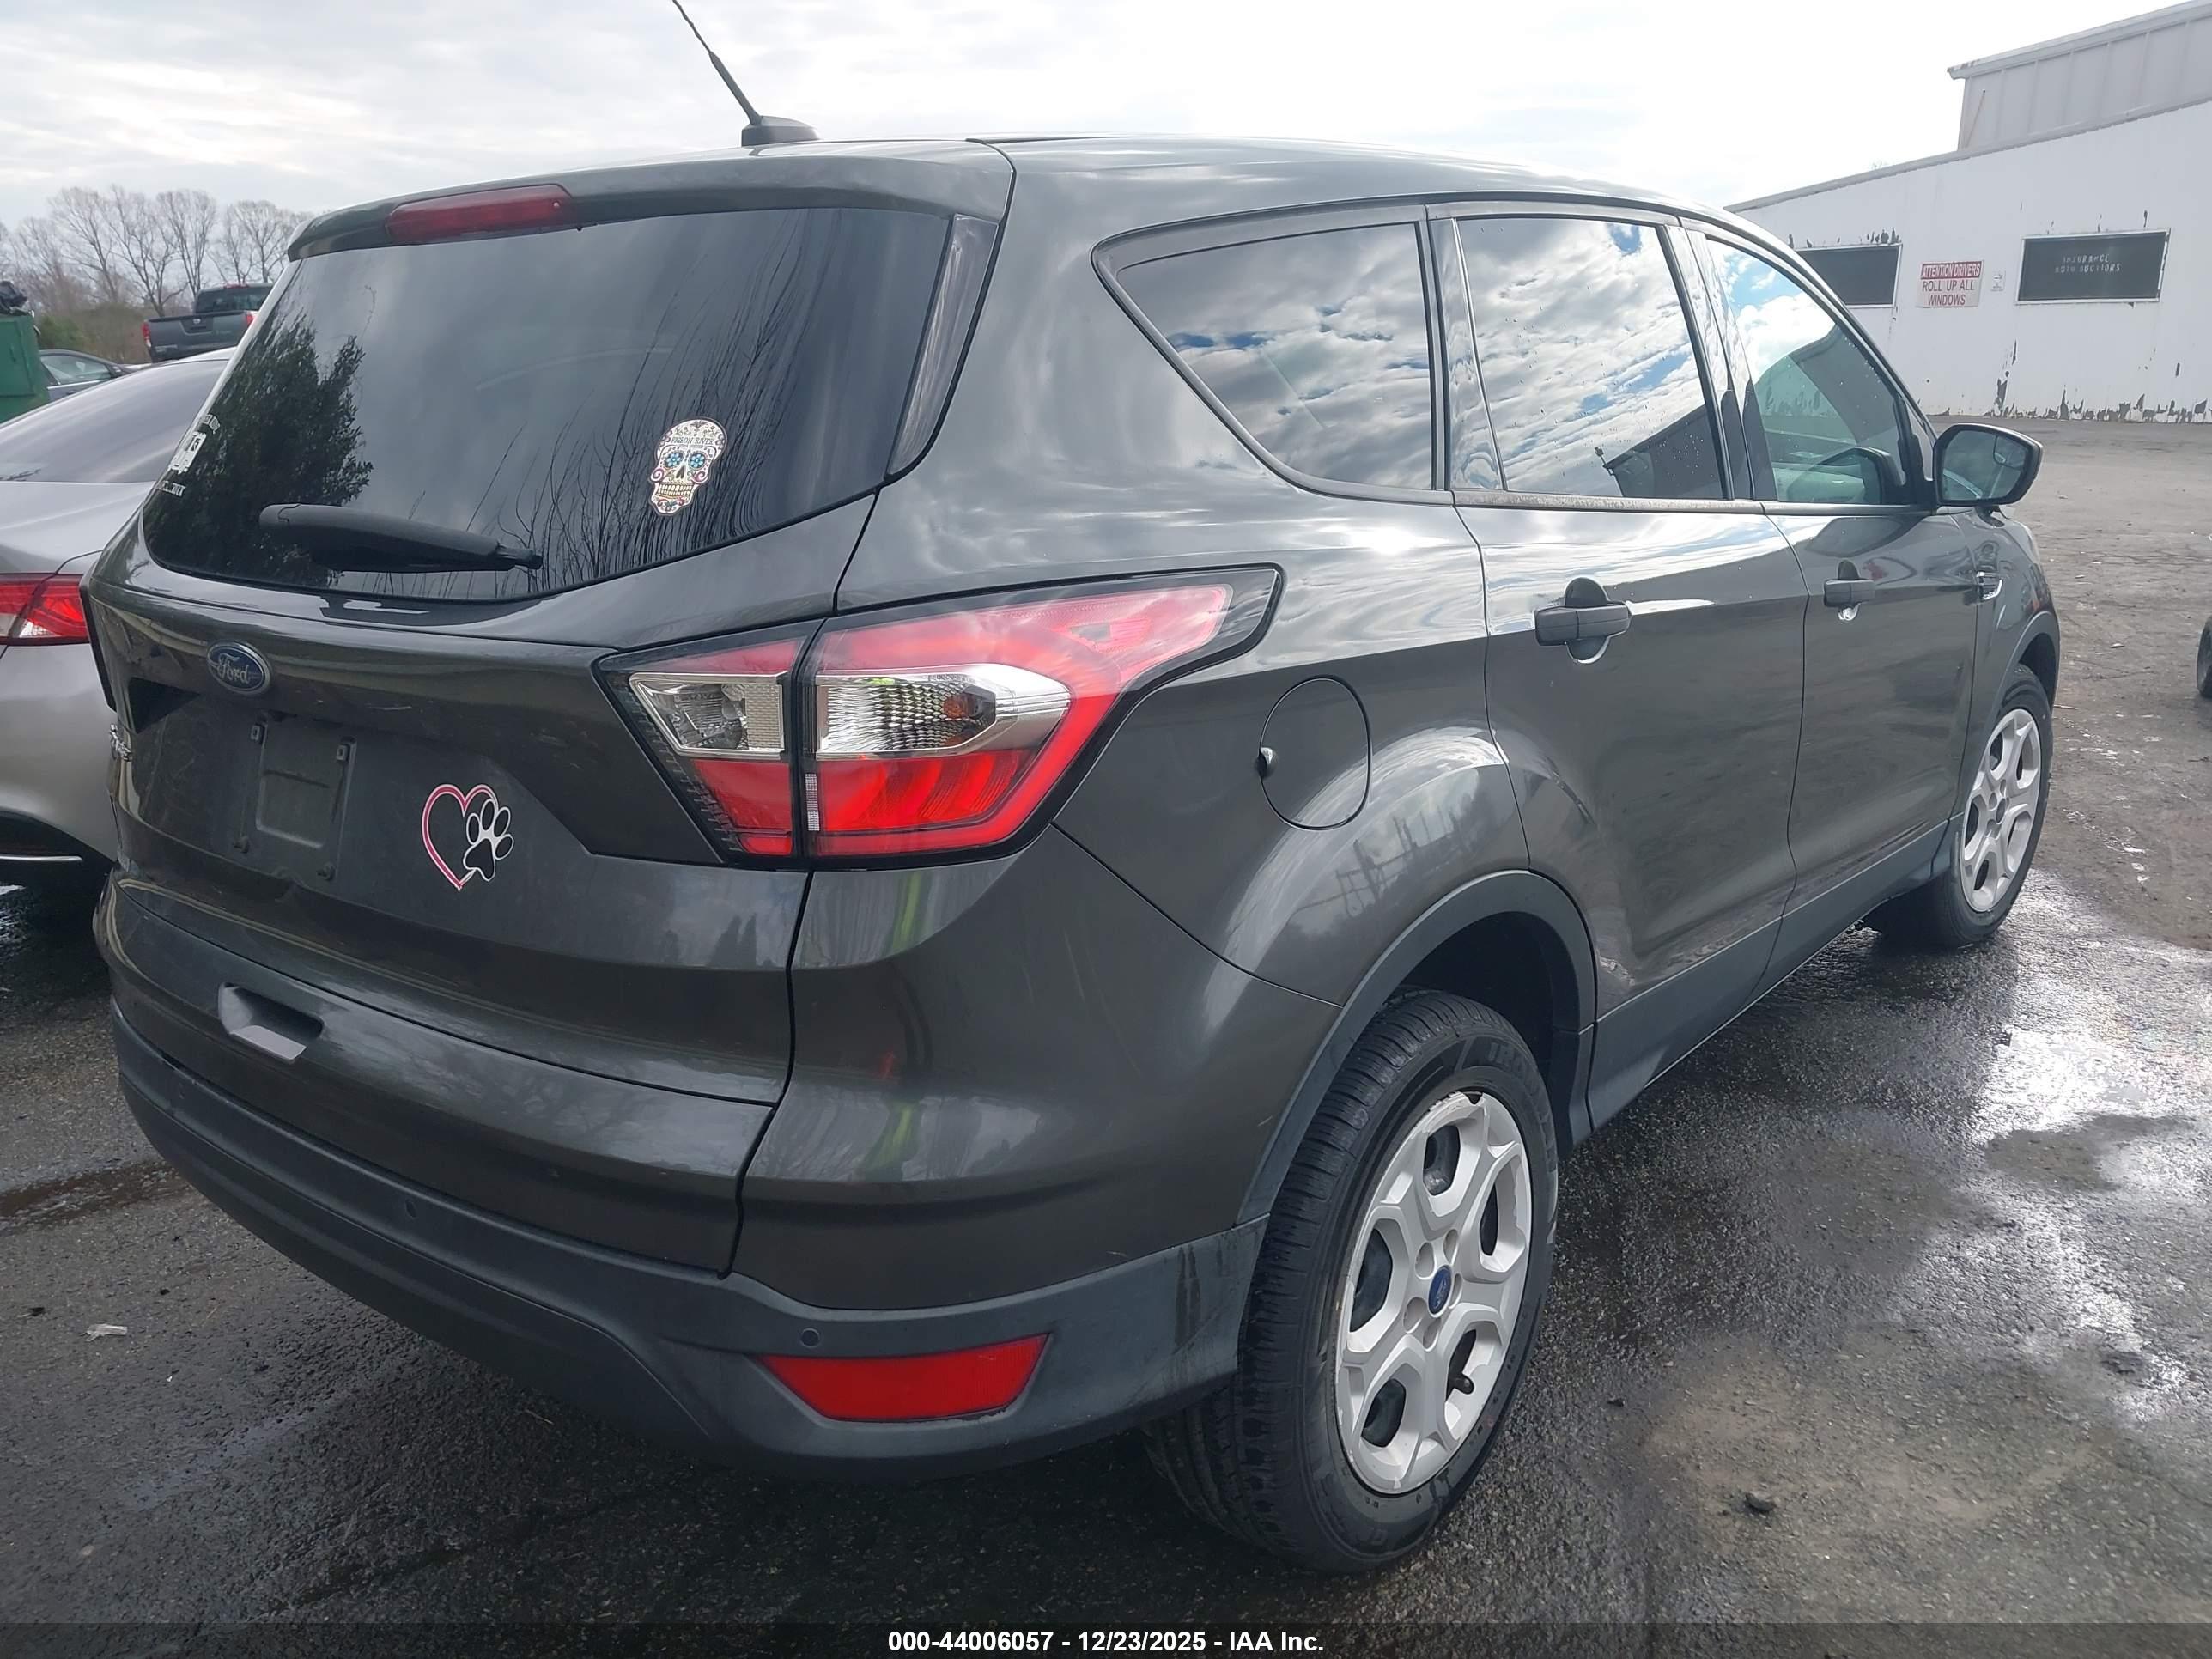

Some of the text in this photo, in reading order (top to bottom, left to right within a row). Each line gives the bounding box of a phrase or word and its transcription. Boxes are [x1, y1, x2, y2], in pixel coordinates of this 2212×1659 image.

[1923, 263, 1980, 278] ATTENTION DRIVERS
[1923, 279, 1975, 292] ROLL UP ALL
[1928, 294, 1966, 306] WINDOWS
[217, 652, 251, 684] Ford
